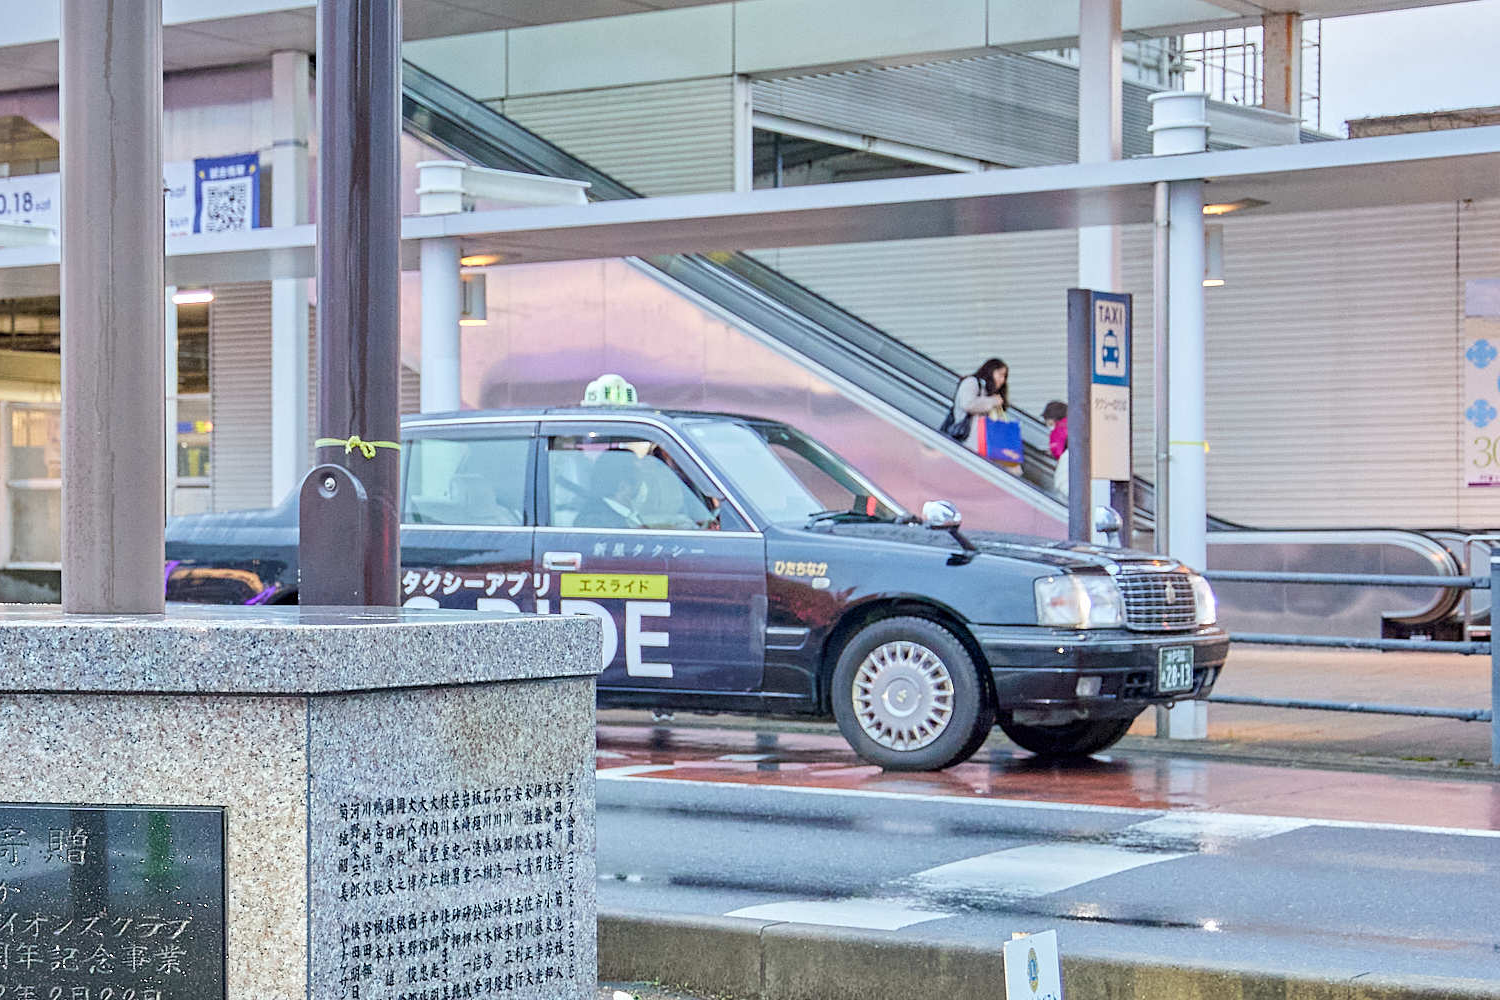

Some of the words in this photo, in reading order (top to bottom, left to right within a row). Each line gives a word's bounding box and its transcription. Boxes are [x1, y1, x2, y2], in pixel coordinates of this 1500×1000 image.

[1098, 306, 1123, 324] TAXI
[592, 542, 706, 558] 新星タクシー
[774, 560, 828, 576] ひたちなか
[402, 570, 551, 598] タクシーアプリ
[579, 579, 649, 593] エスライド
